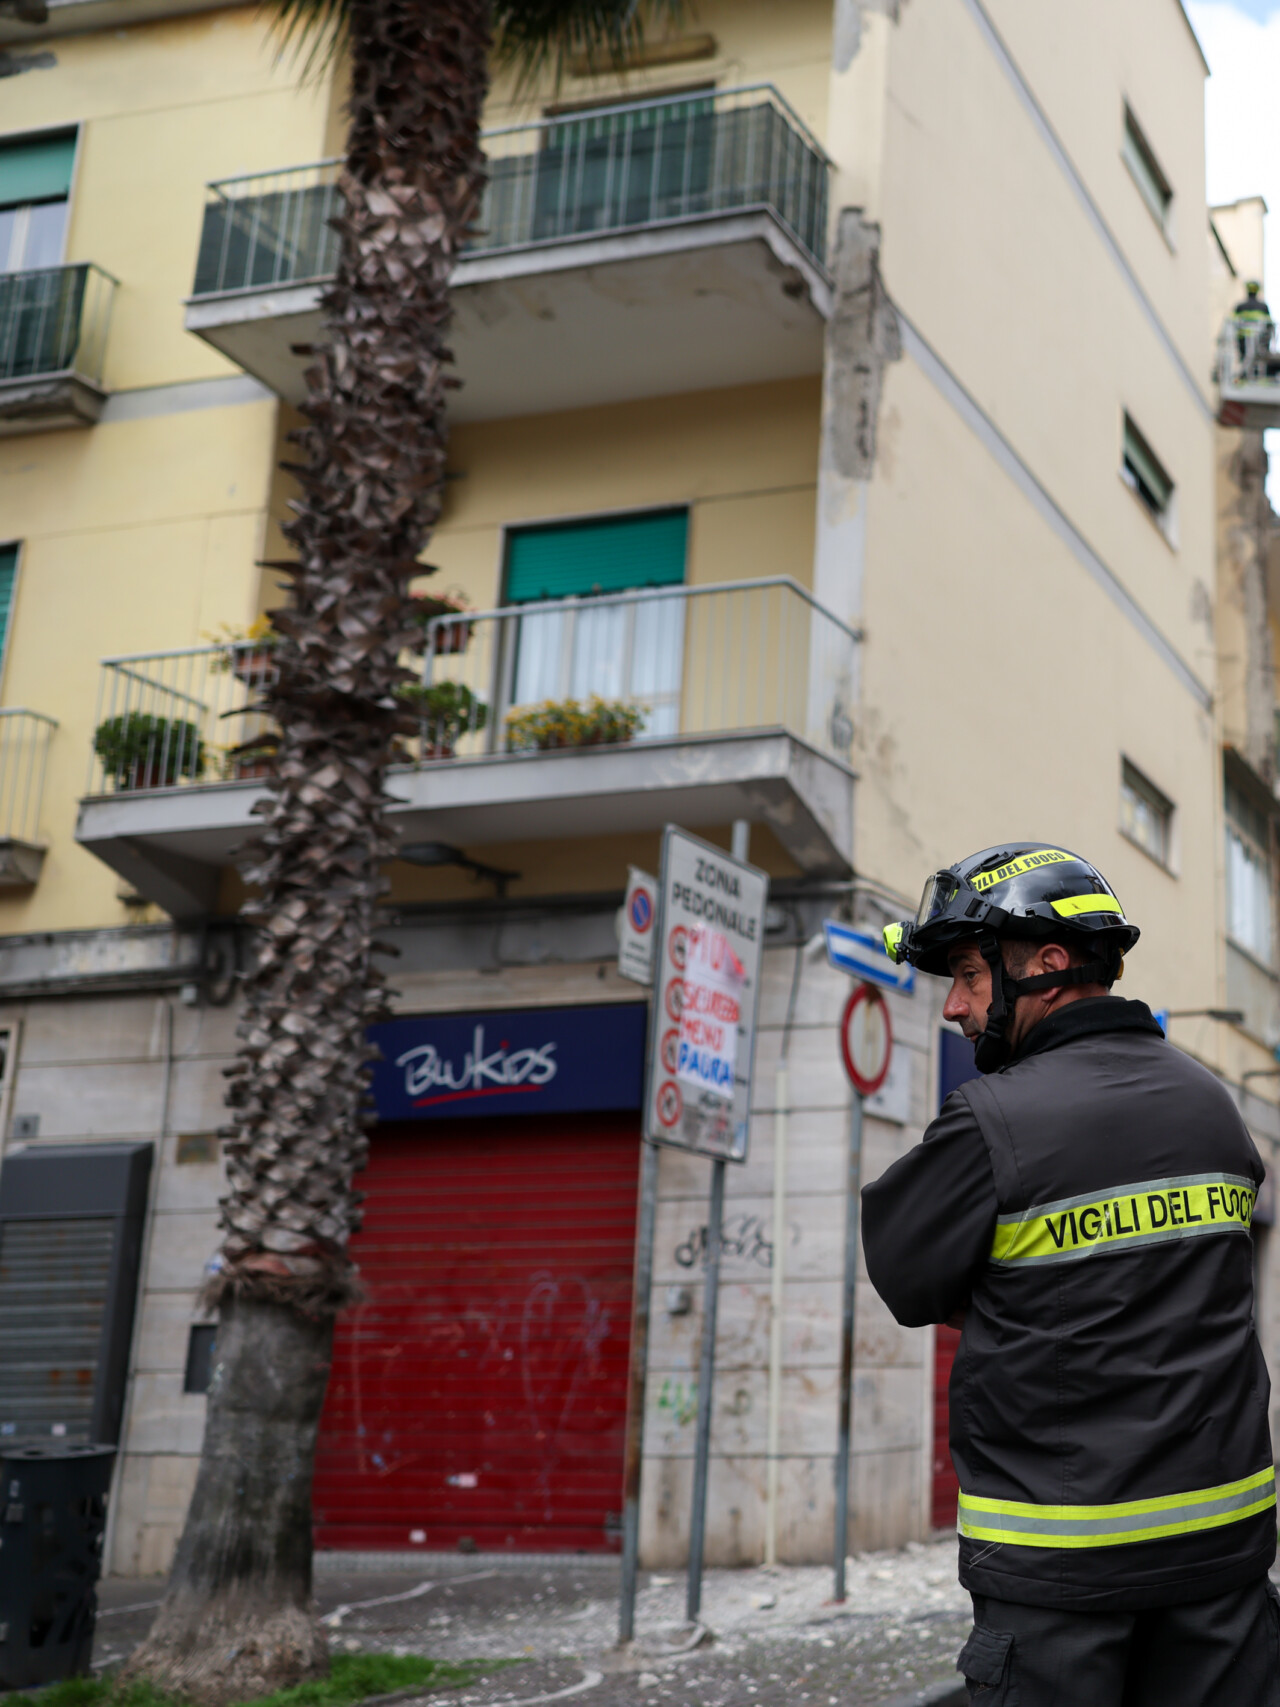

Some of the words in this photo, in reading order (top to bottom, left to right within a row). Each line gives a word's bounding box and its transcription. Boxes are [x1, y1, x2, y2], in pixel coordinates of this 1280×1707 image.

[695, 857, 741, 900] ZONA
[996, 863, 1023, 880] DEL
[1022, 852, 1066, 868] FUOCO
[671, 881, 756, 942] PEDONALE
[677, 1042, 735, 1090] PAURA
[1045, 1197, 1142, 1249] VIGILI
[1147, 1189, 1203, 1229] DEL
